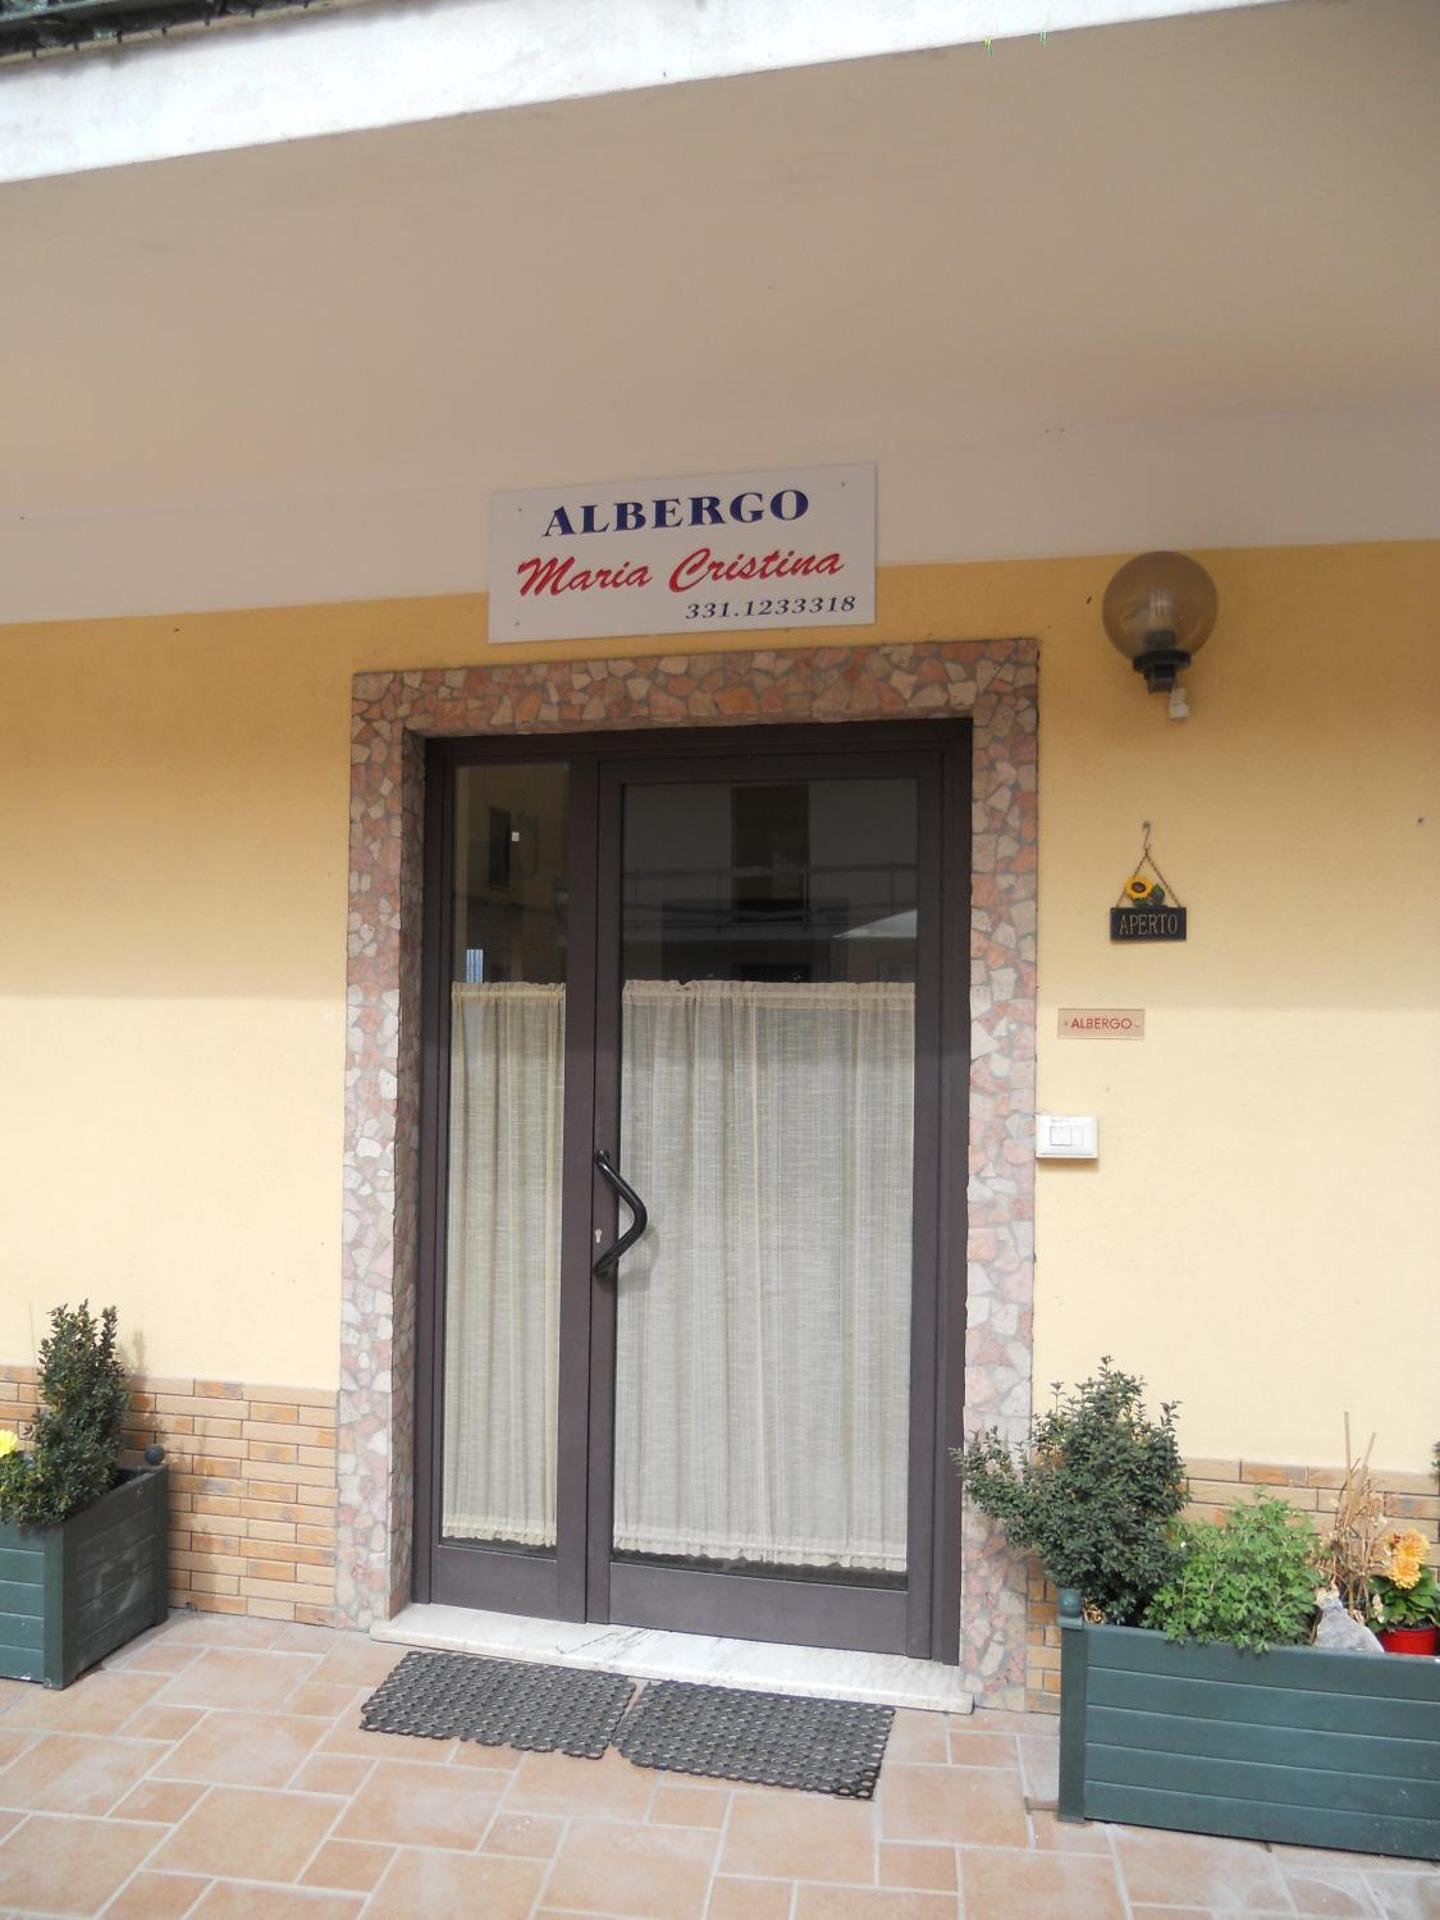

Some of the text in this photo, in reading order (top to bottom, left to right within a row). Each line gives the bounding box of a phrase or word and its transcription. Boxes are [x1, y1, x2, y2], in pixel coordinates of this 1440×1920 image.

[541, 488, 809, 537] ALBERGO
[516, 547, 845, 597] Maria Cristina
[685, 595, 856, 620] 331.1233318
[1119, 913, 1178, 936] APERTO
[1070, 1017, 1133, 1030] ALBERGO
